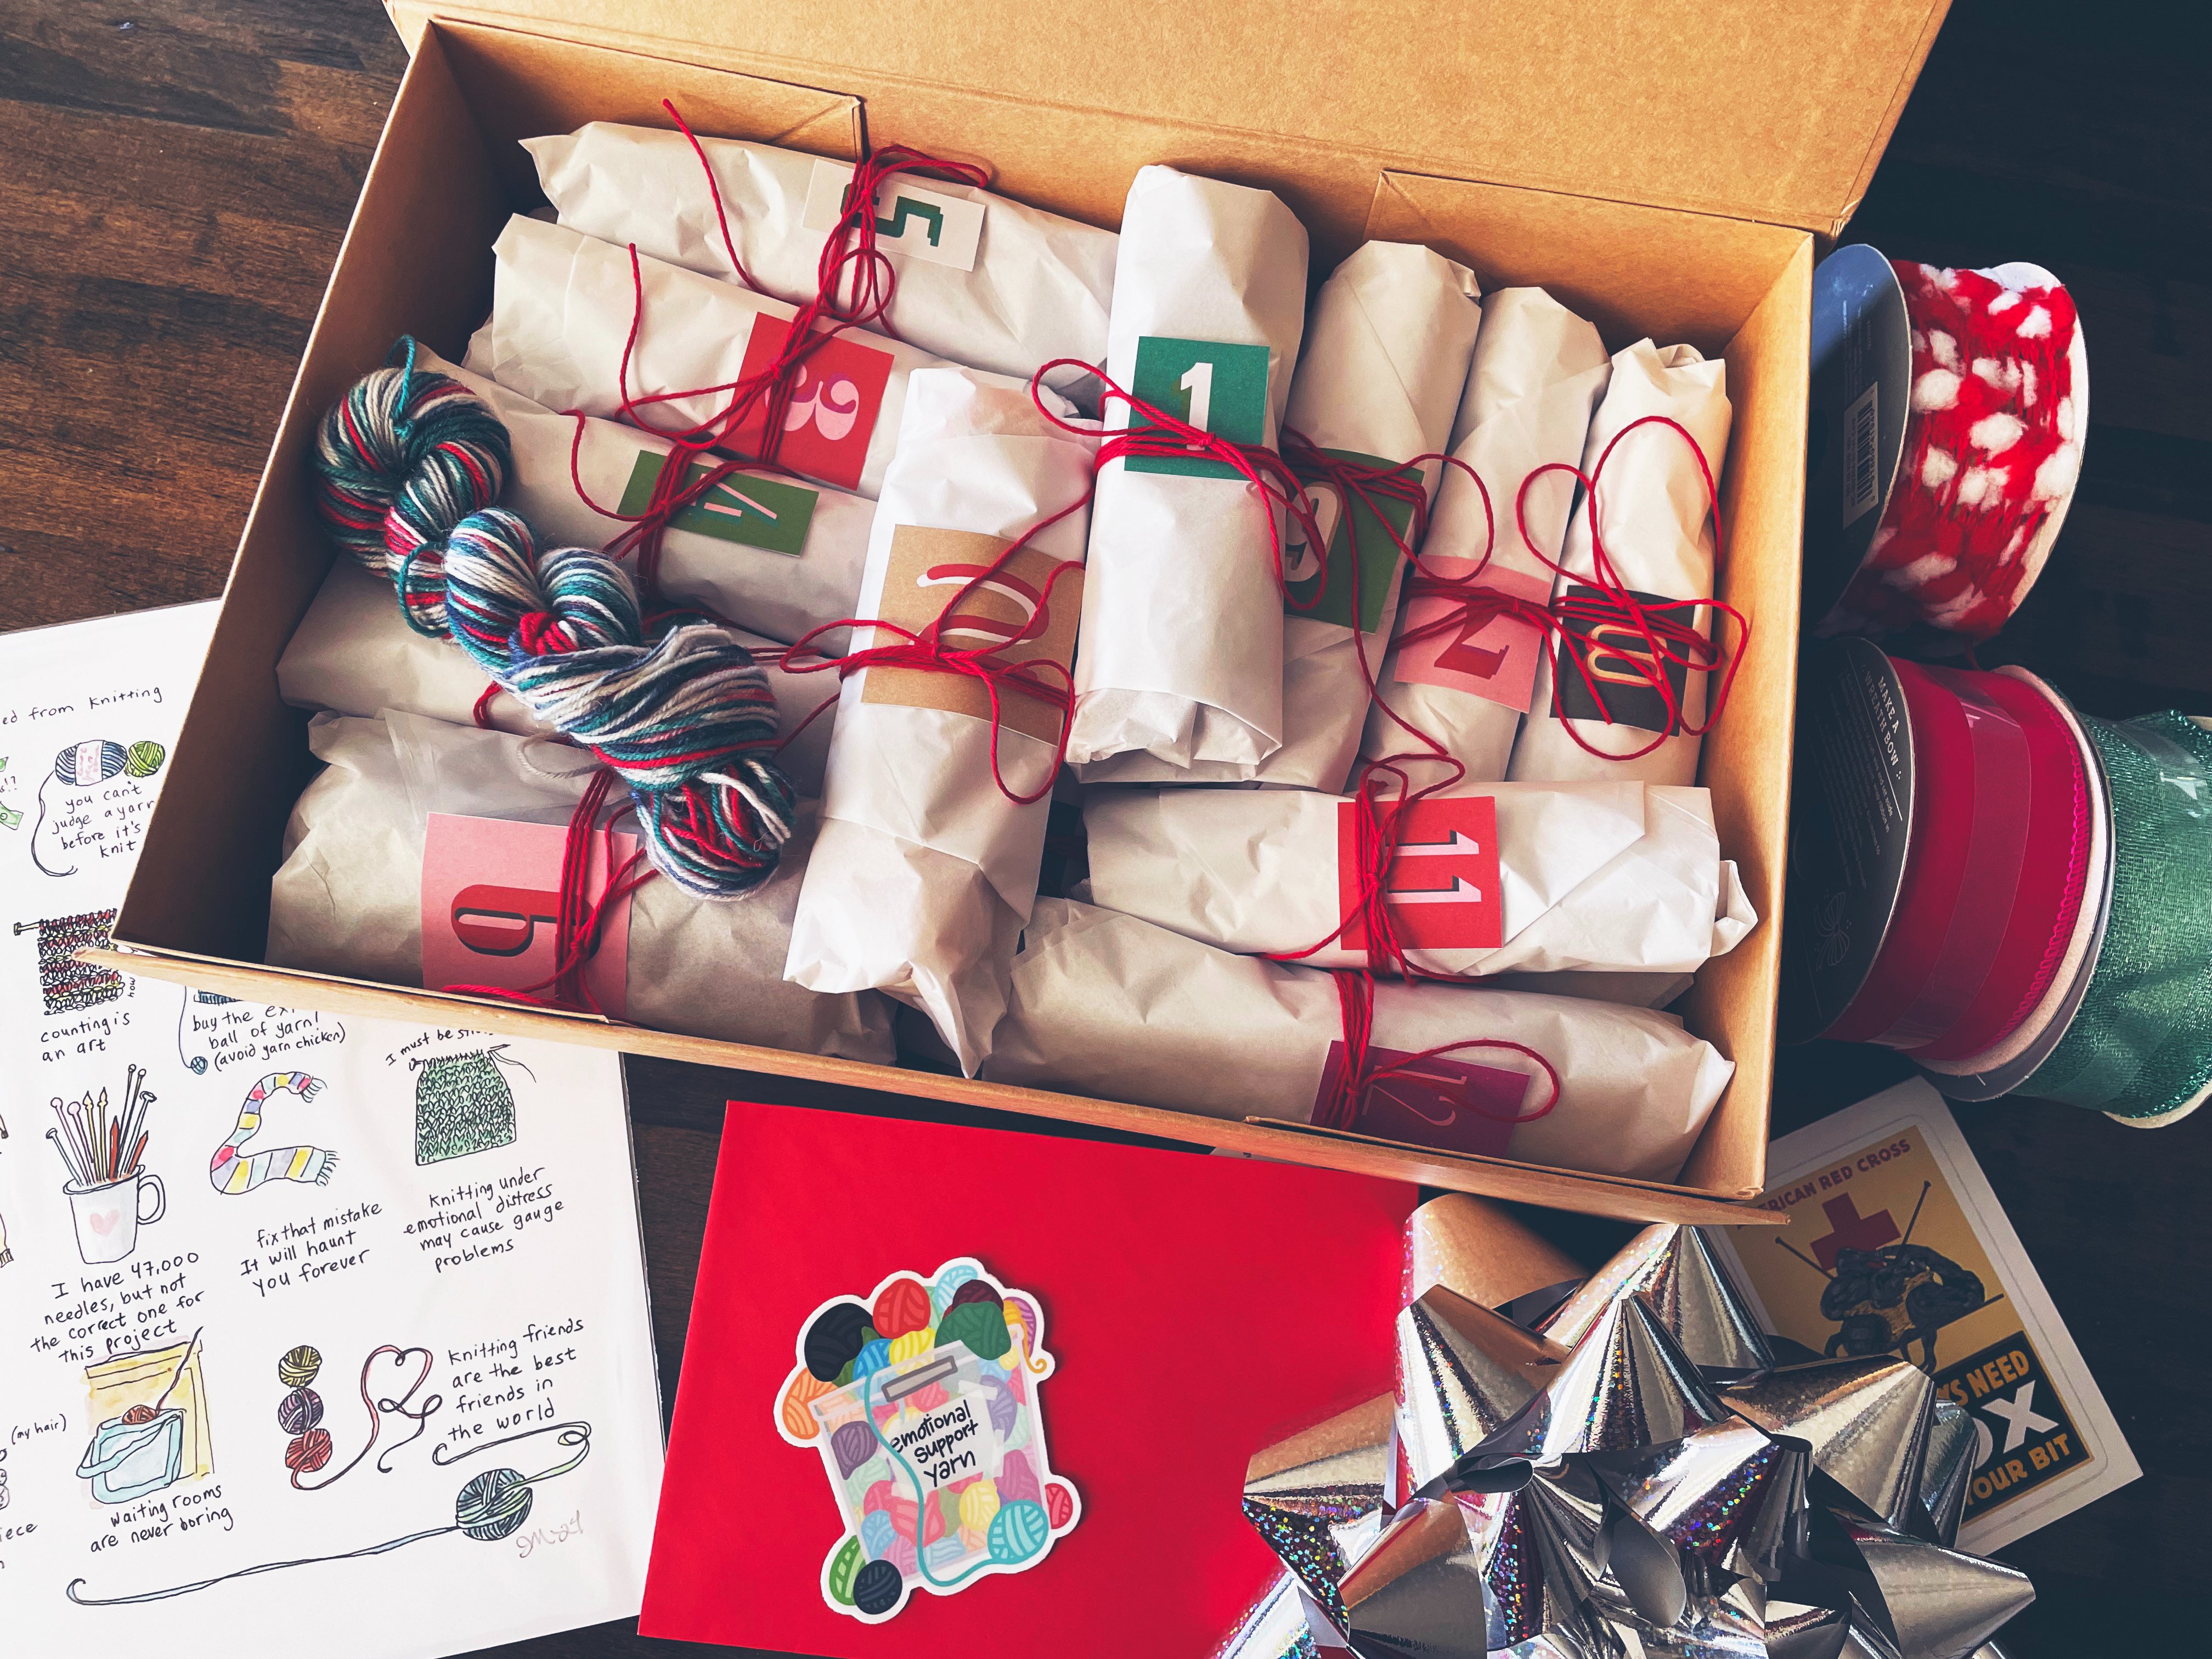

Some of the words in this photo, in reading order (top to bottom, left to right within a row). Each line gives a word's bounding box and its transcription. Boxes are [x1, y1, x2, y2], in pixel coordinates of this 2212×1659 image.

[1181, 362, 1213, 451] 1
[1585, 623, 1667, 687] 8
[29, 706, 74, 720] from
[1878, 675, 1895, 720] MAKE
[1892, 719, 1899, 734] A
[1884, 730, 1899, 766] BOW
[66, 795, 93, 814] you
[104, 781, 142, 800] can't
[52, 815, 92, 834] judge
[61, 831, 105, 850] before
[116, 821, 141, 838] it's
[100, 840, 136, 858] knit
[1383, 829, 1482, 905] 11
[41, 1017, 110, 1042] counting
[114, 1011, 130, 1025] is
[193, 1015, 217, 1031] buy
[222, 1011, 254, 1025] the
[209, 1030, 238, 1049] ball
[251, 1021, 268, 1037] of
[275, 1011, 319, 1039] yarn!
[42, 1049, 65, 1062] an
[77, 1039, 106, 1054] art
[215, 1044, 256, 1072] (avoid
[262, 1042, 291, 1060] yarn
[296, 1021, 346, 1049] chicken)
[385, 1053, 397, 1066] I
[400, 1031, 430, 1056] must
[437, 1029, 453, 1041] be
[499, 1166, 545, 1189] under
[1818, 1165, 1853, 1191] RED
[1857, 1138, 1911, 1172] CROSS
[257, 1229, 279, 1248] fix
[281, 1216, 317, 1240] that
[324, 1203, 383, 1231] mistake
[403, 1201, 483, 1234] emotional
[496, 1183, 553, 1213] distress
[420, 1233, 453, 1251] may
[460, 1222, 505, 1238] cause
[513, 1201, 565, 1231] gauge
[269, 1244, 297, 1265] will
[306, 1229, 357, 1256] haunt
[299, 1249, 370, 1282] forever
[435, 1239, 515, 1273] problems
[52, 1282, 69, 1299] I
[81, 1272, 125, 1293] have
[131, 1252, 199, 1279] 47,000
[44, 1297, 115, 1325] needles,
[120, 1284, 153, 1305] but
[160, 1273, 186, 1294] not
[30, 1335, 60, 1352] the
[69, 1313, 127, 1340] correct
[137, 1303, 168, 1323] one
[176, 1290, 205, 1309] for
[58, 1345, 94, 1363] this
[106, 1319, 177, 1355] project
[522, 1318, 584, 1342] friends
[452, 1373, 483, 1389] are
[488, 1363, 523, 1378] the
[533, 1347, 577, 1370] best
[1966, 1350, 2029, 1398] NEED
[456, 1385, 525, 1413] friends
[535, 1379, 554, 1392] in
[11, 1425, 31, 1446] (my
[34, 1413, 66, 1434] hair)
[448, 1423, 484, 1442] the
[496, 1397, 555, 1429] world
[890, 1399, 971, 1453] emotional
[914, 1419, 979, 1464] support
[2028, 1433, 2070, 1471] BIT
[110, 1500, 169, 1527] waiting
[172, 1484, 222, 1509] rooms
[90, 1534, 119, 1553] are
[131, 1522, 173, 1543] never
[180, 1507, 234, 1531] boring
